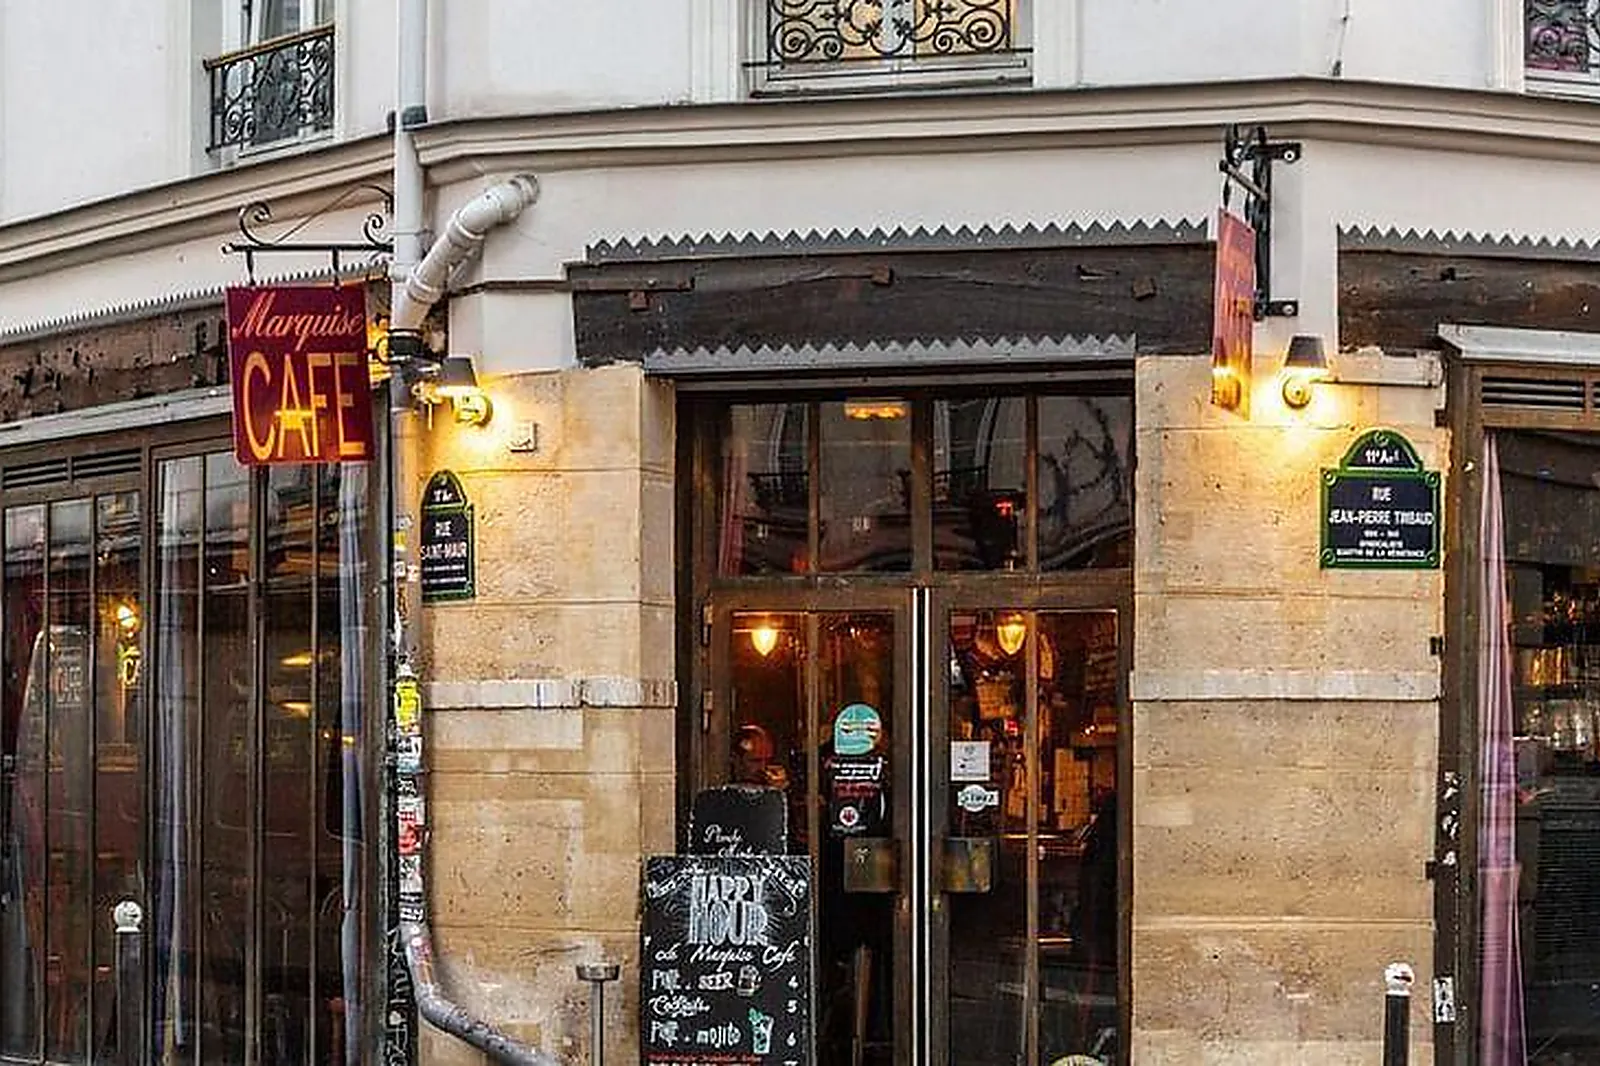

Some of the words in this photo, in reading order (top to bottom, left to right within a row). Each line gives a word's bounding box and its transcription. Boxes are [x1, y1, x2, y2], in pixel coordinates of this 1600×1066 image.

[232, 291, 364, 351] Marquise
[1371, 486, 1392, 501] RUE
[1328, 508, 1391, 525] JEAN-PIERRE
[691, 874, 768, 902] HAPPY
[686, 900, 769, 946] HOUR
